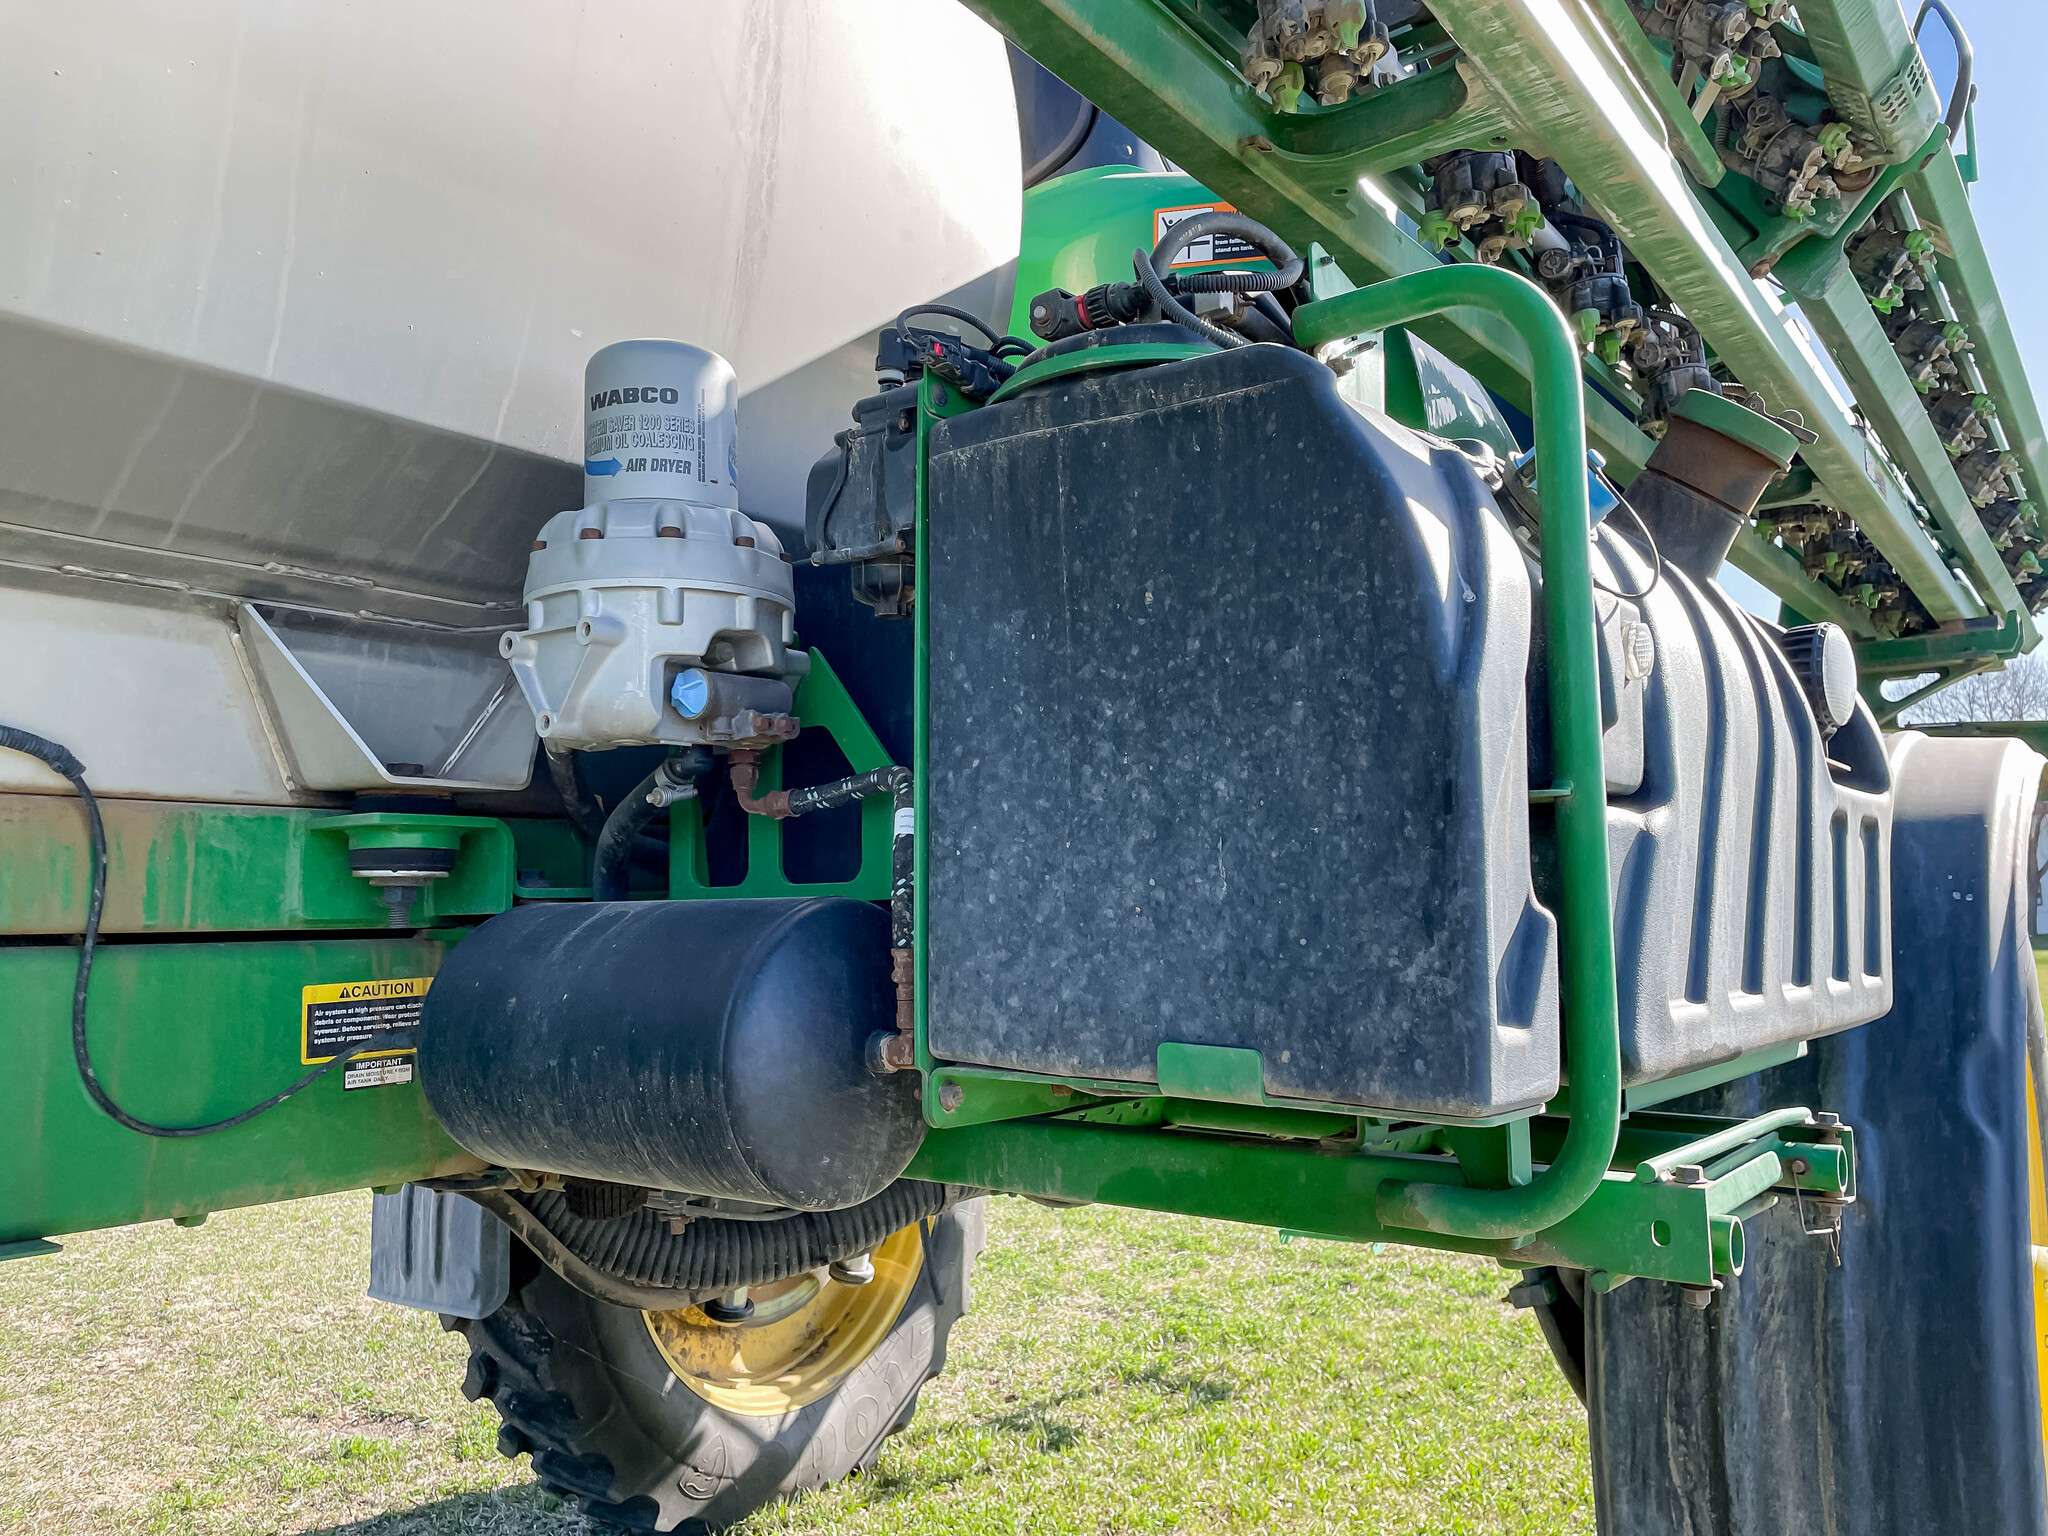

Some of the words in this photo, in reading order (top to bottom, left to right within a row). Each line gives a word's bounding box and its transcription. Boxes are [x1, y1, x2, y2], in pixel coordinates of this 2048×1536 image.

[590, 386, 679, 411] WABCO
[608, 414, 636, 433] SAVER
[639, 414, 661, 431] 1200
[664, 415, 696, 434] SERIES
[586, 434, 613, 457] EMIUM
[614, 433, 629, 450] OIL
[632, 432, 695, 452] COALESCING
[625, 457, 648, 473] AIR
[650, 457, 692, 475] DRYER
[352, 982, 413, 997] CAUTION
[325, 1008, 347, 1017] system
[355, 1005, 369, 1015] high
[369, 1004, 395, 1014] pressure
[314, 1018, 334, 1026] debris
[343, 1014, 382, 1025] components.
[382, 1012, 397, 1020] Wear
[313, 1027, 341, 1035] eyewear.
[341, 1025, 362, 1033] Before
[363, 1021, 392, 1031] servicing,
[392, 1020, 412, 1028] relieve
[314, 1036, 336, 1045] system
[337, 1034, 346, 1042] air
[356, 1058, 402, 1069] IMPORTANT
[346, 1070, 365, 1079] DRAIN
[365, 1068, 394, 1077] MOISTURE
